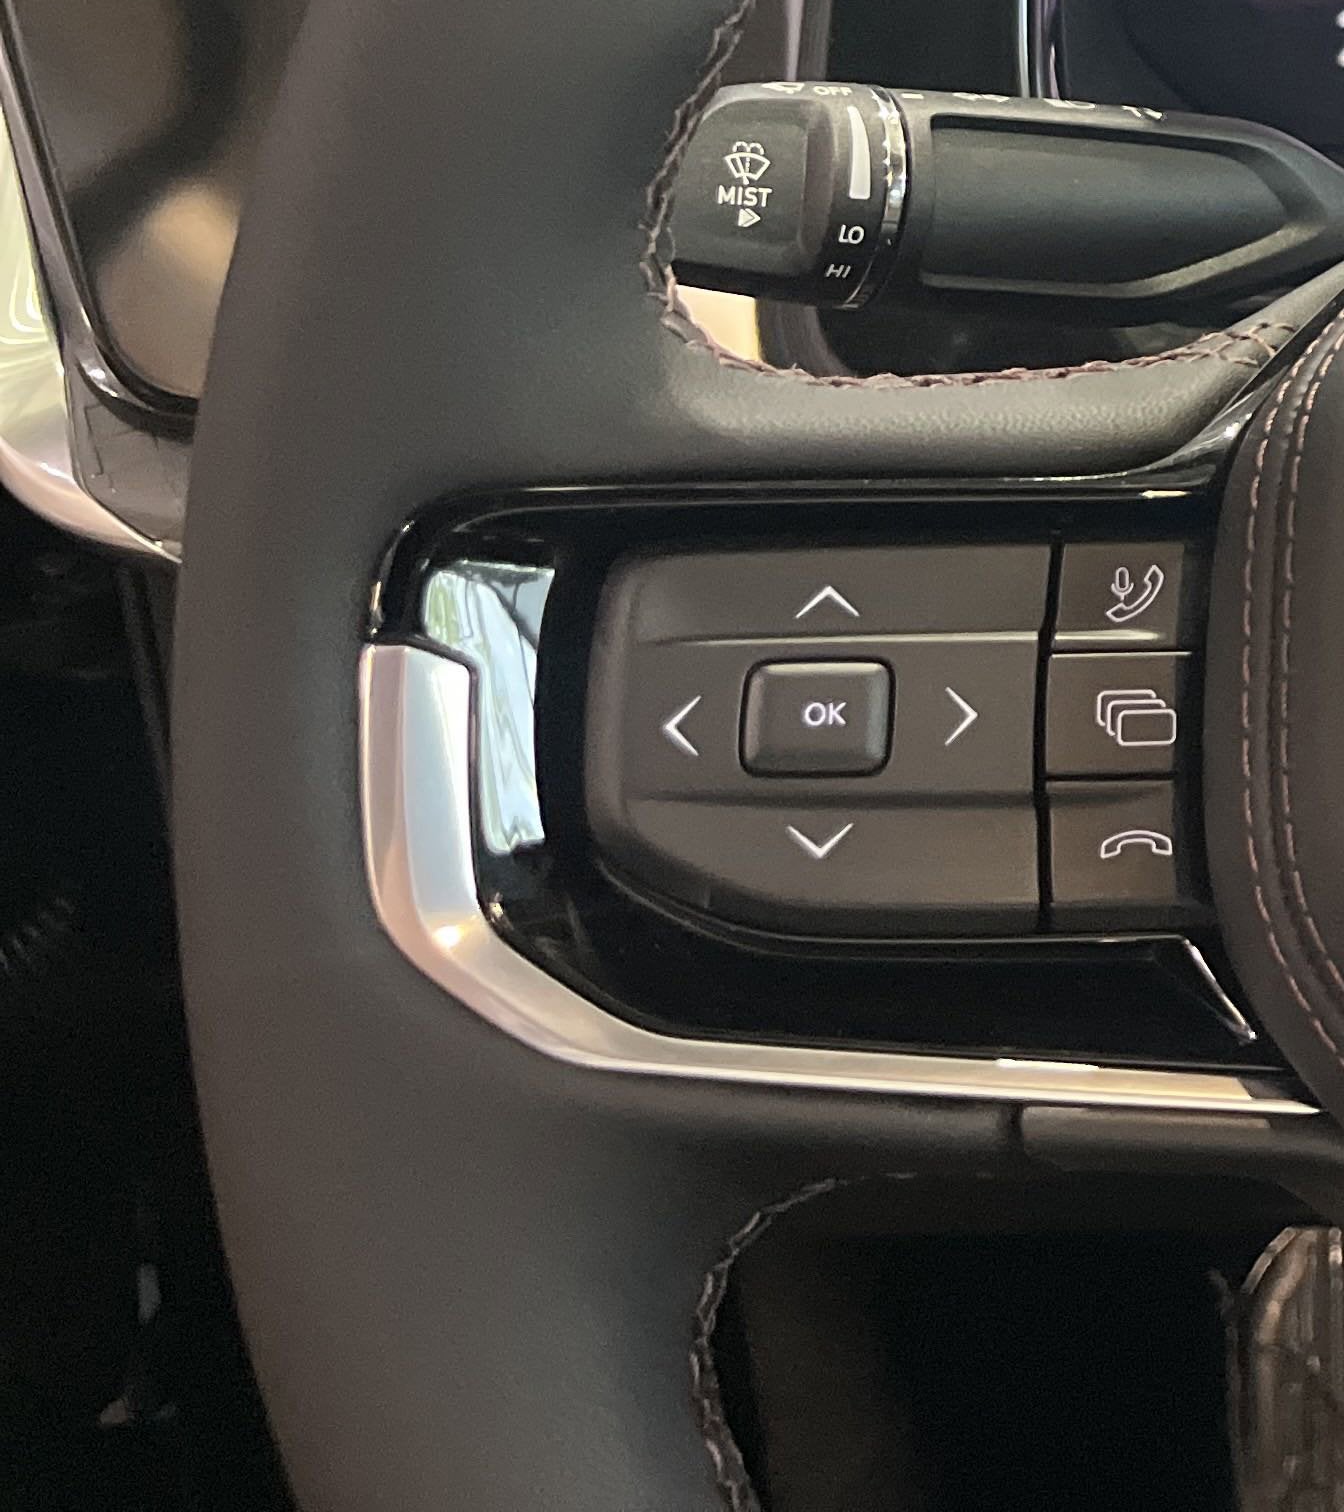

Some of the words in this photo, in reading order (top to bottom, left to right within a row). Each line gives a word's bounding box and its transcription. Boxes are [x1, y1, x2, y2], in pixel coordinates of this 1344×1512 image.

[812, 84, 853, 97] OFF
[717, 186, 773, 208] MIST
[837, 224, 865, 246] LO
[825, 263, 851, 280] HI
[804, 701, 847, 727] OK
